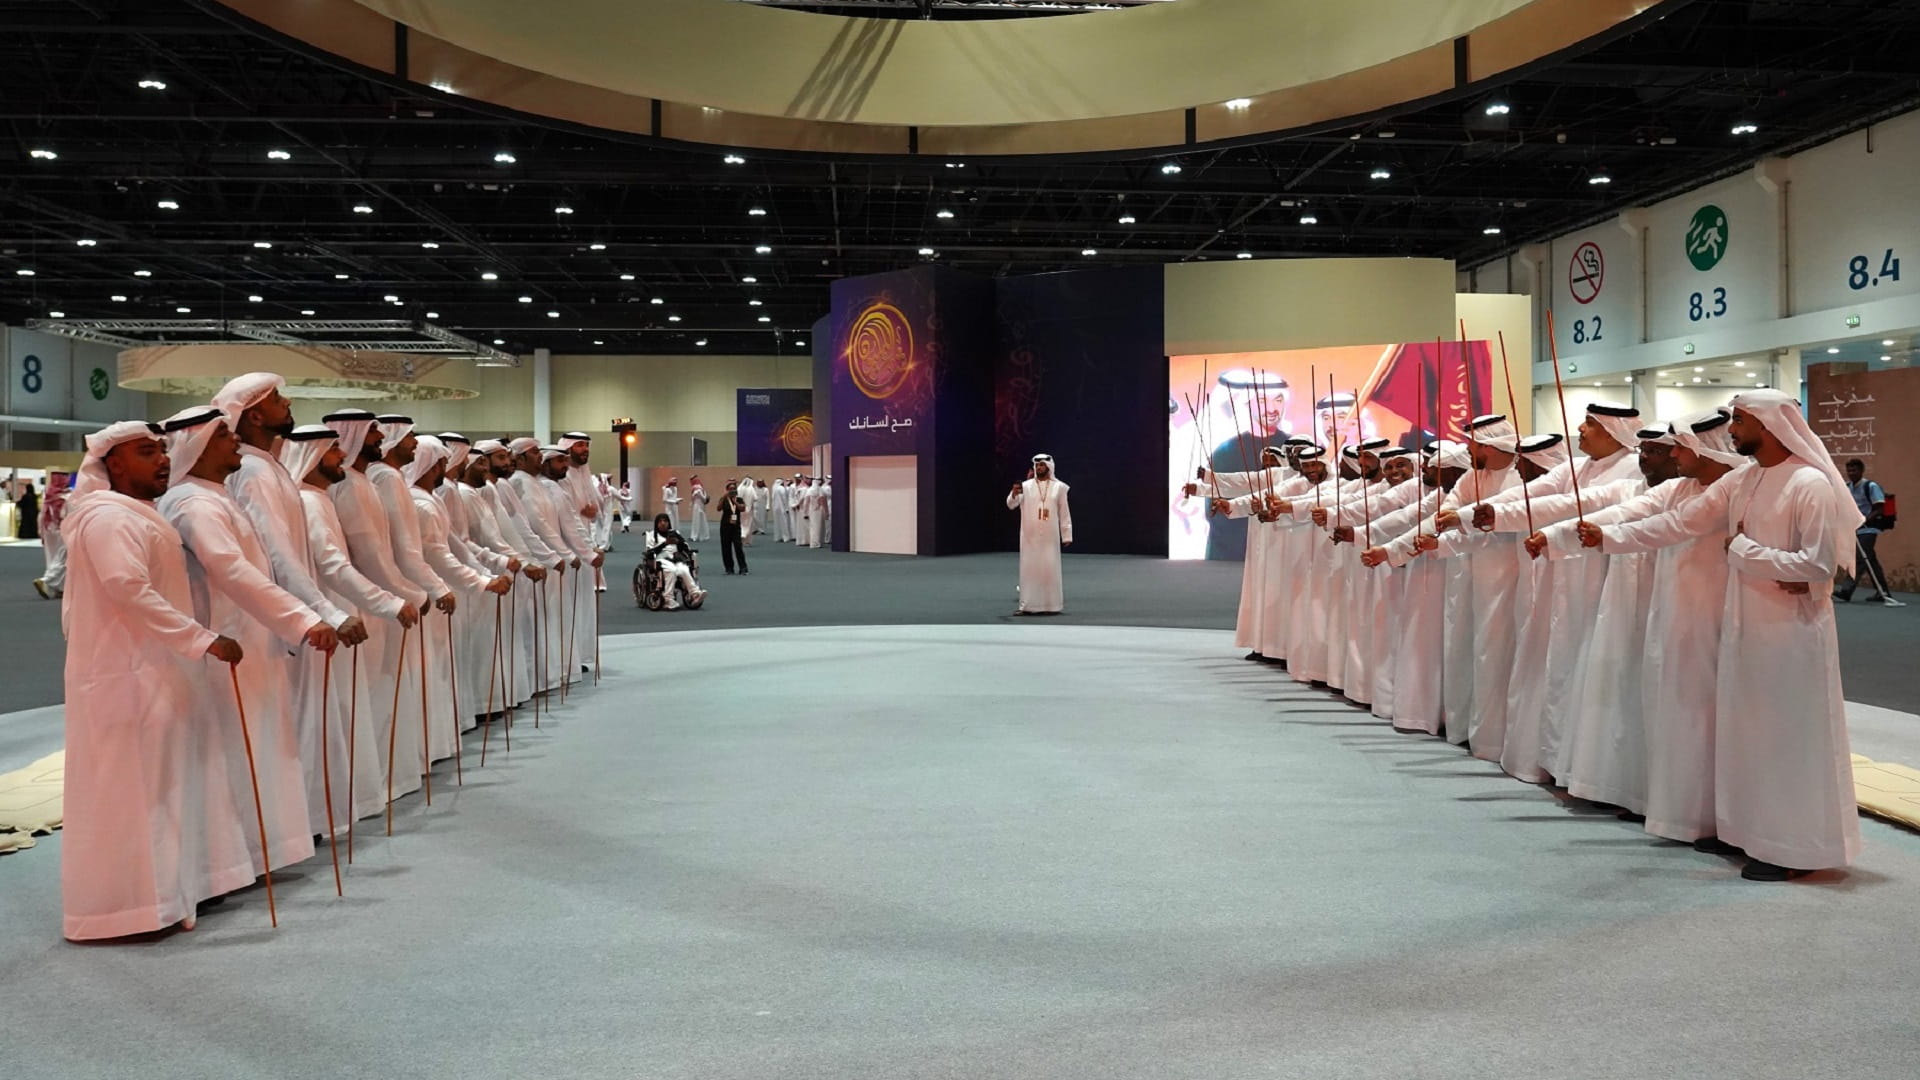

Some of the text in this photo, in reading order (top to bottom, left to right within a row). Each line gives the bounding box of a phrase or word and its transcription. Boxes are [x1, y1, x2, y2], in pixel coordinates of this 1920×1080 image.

[1848, 247, 1900, 290] 8.4
[1689, 286, 1728, 322] 8.3
[1573, 315, 1603, 344] 8.2
[22, 354, 43, 394] 8
[848, 414, 913, 433] صح لسانك
